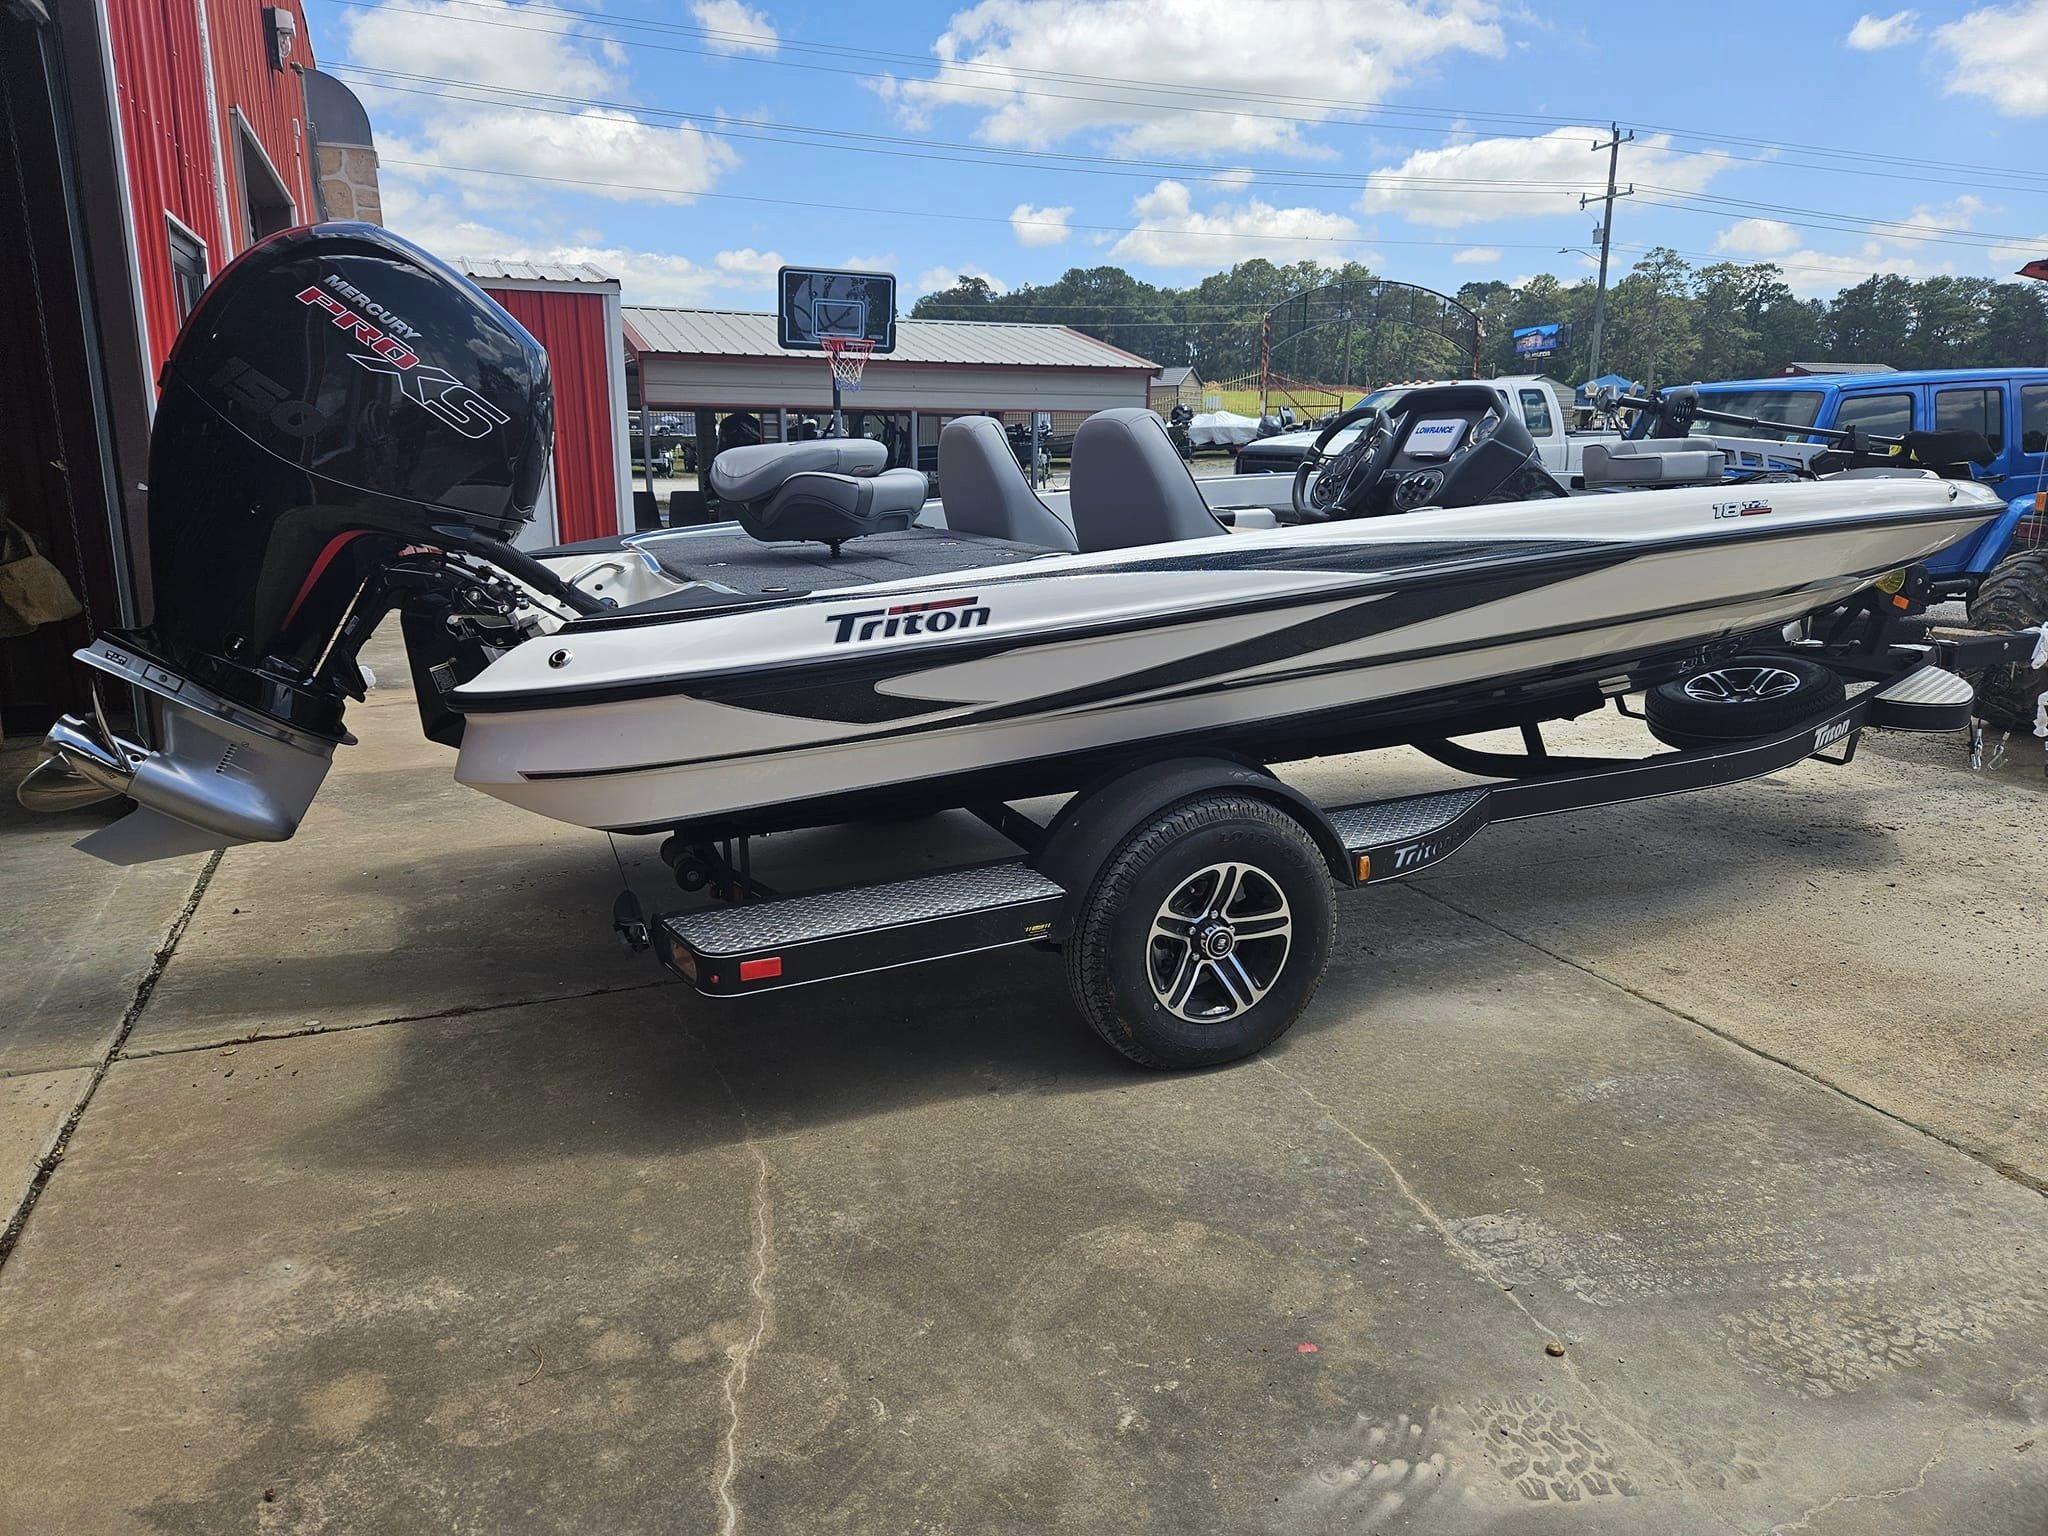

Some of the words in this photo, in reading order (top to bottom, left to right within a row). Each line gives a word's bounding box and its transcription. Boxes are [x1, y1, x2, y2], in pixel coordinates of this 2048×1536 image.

[324, 274, 422, 339] MERCURY
[295, 286, 420, 370] PRO
[346, 334, 511, 439] XS
[1415, 426, 1456, 435] LOWRANCE
[1713, 502, 1740, 519] 18
[826, 603, 991, 643] Triton
[1813, 719, 1851, 750] Triton
